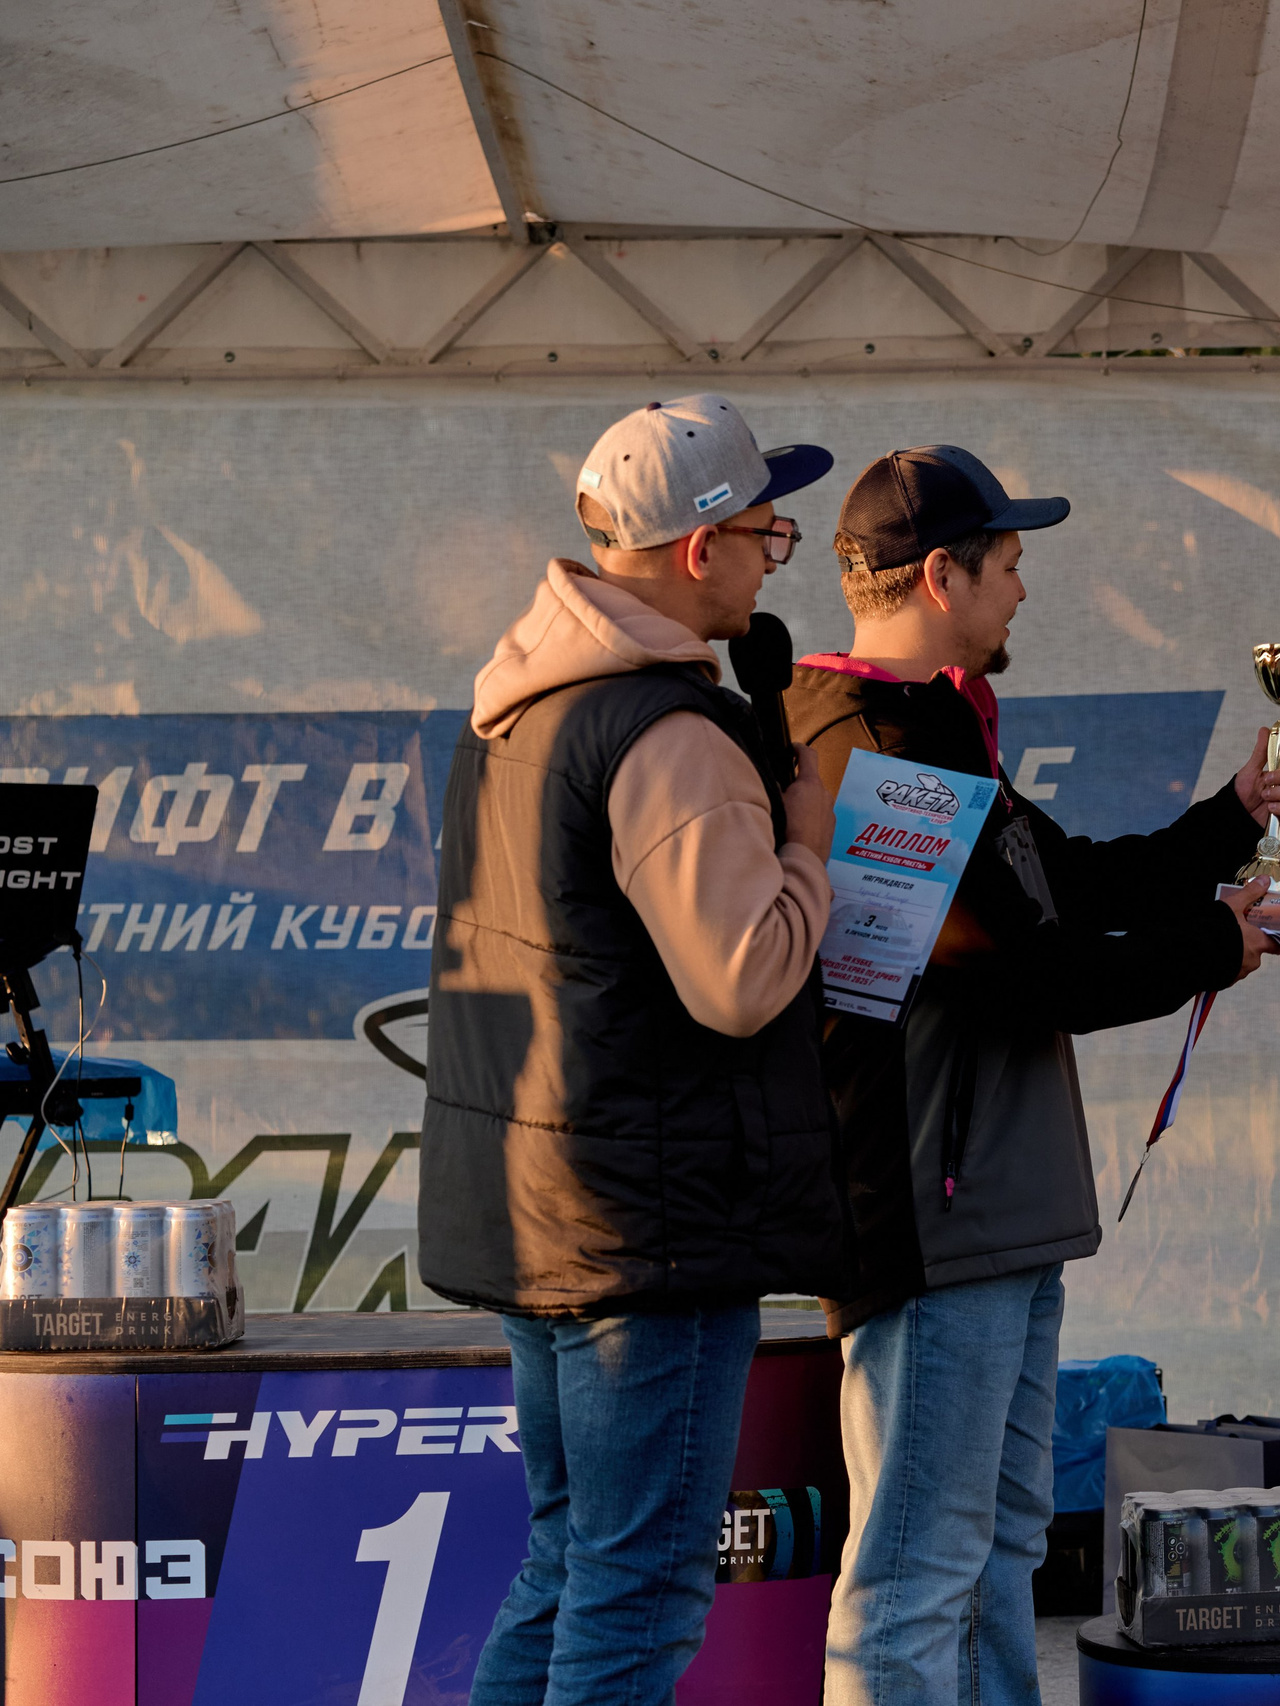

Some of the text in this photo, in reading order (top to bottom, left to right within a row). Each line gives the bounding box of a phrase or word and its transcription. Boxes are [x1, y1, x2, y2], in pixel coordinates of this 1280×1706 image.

[0, 762, 411, 856] ИФТ В
[876, 779, 961, 817] РАКЕТА
[854, 822, 952, 857] ДИПЛОМ
[57, 892, 437, 952] ТНИЙ КУБО
[864, 915, 877, 928] 3
[33, 1311, 185, 1337] TARGET ENERGY
[116, 1326, 173, 1336] DRINK
[200, 1405, 522, 1460] HYPER
[717, 1508, 771, 1552] GET
[720, 1555, 765, 1565] DRINK
[355, 1491, 451, 1706] 1
[1176, 1605, 1244, 1631] TARGET
